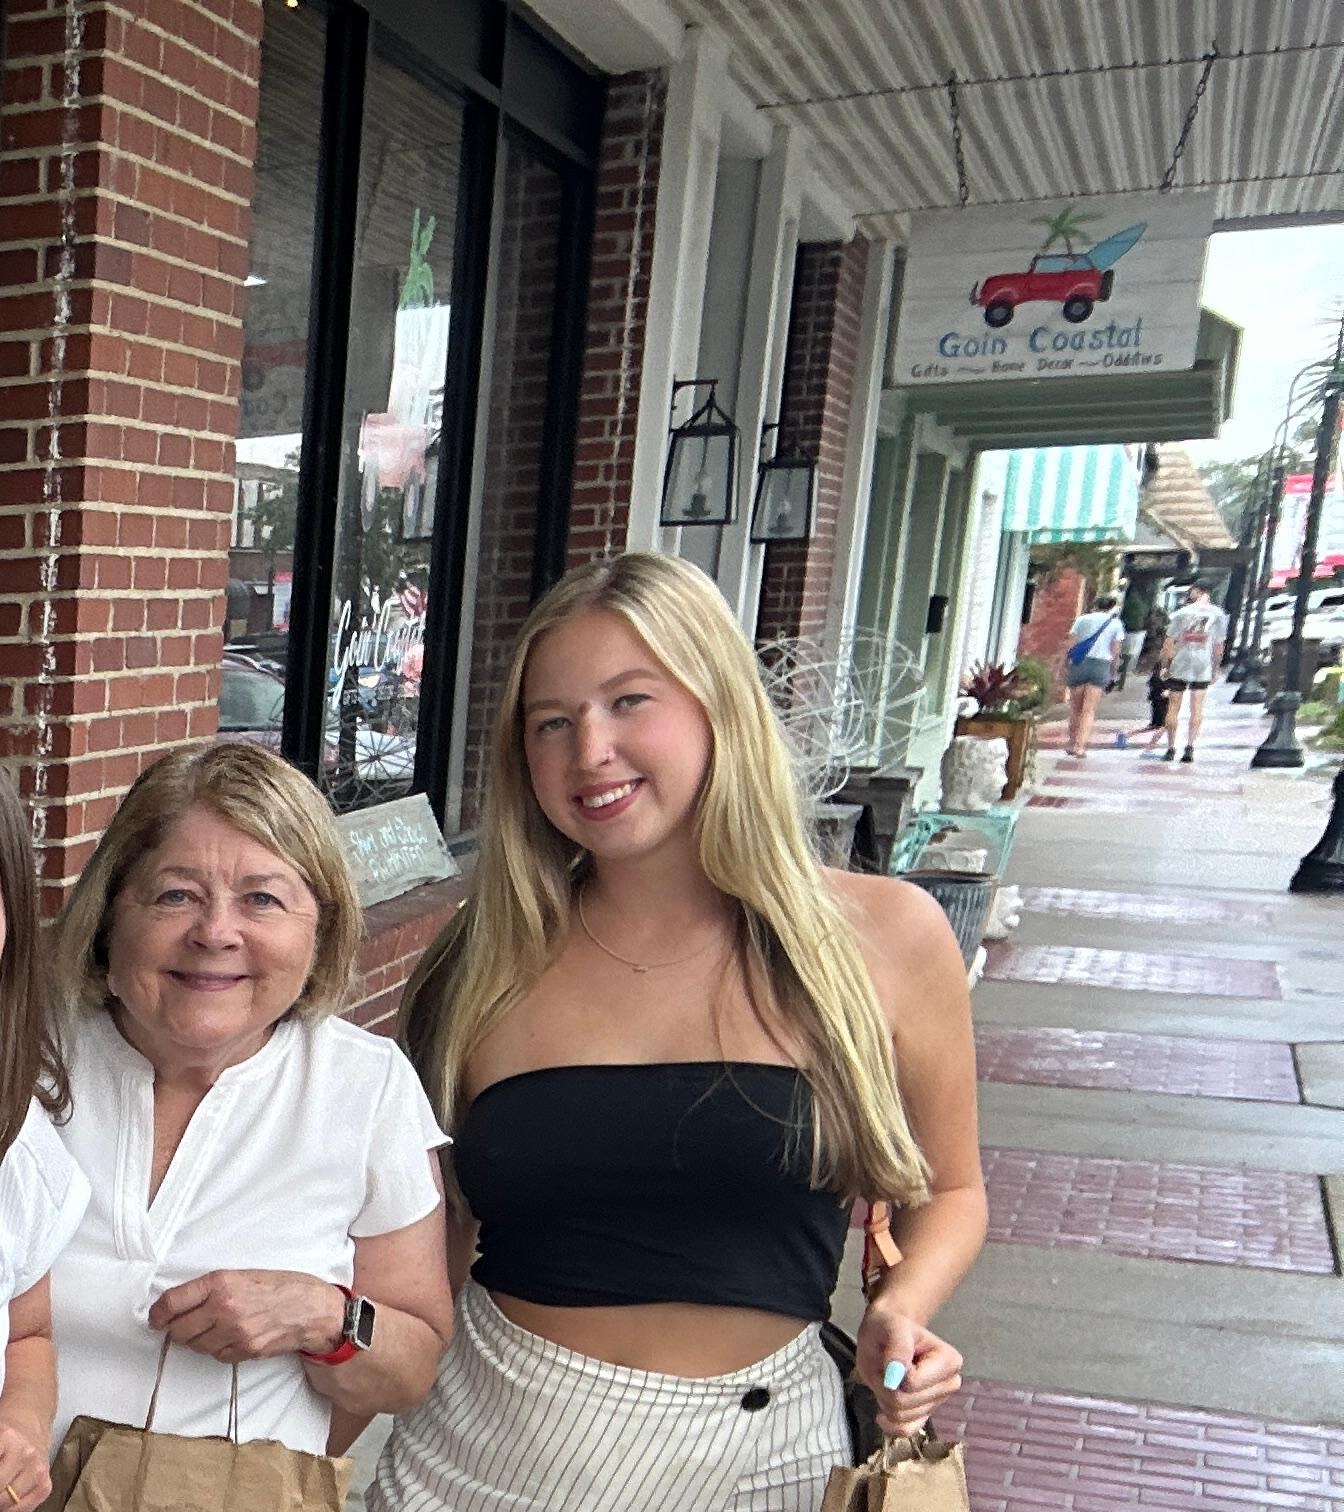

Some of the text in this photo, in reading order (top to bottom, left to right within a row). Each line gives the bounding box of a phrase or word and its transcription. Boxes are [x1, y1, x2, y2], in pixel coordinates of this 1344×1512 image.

[938, 316, 1143, 359] Goin Coastal
[1036, 356, 1075, 372] Decor
